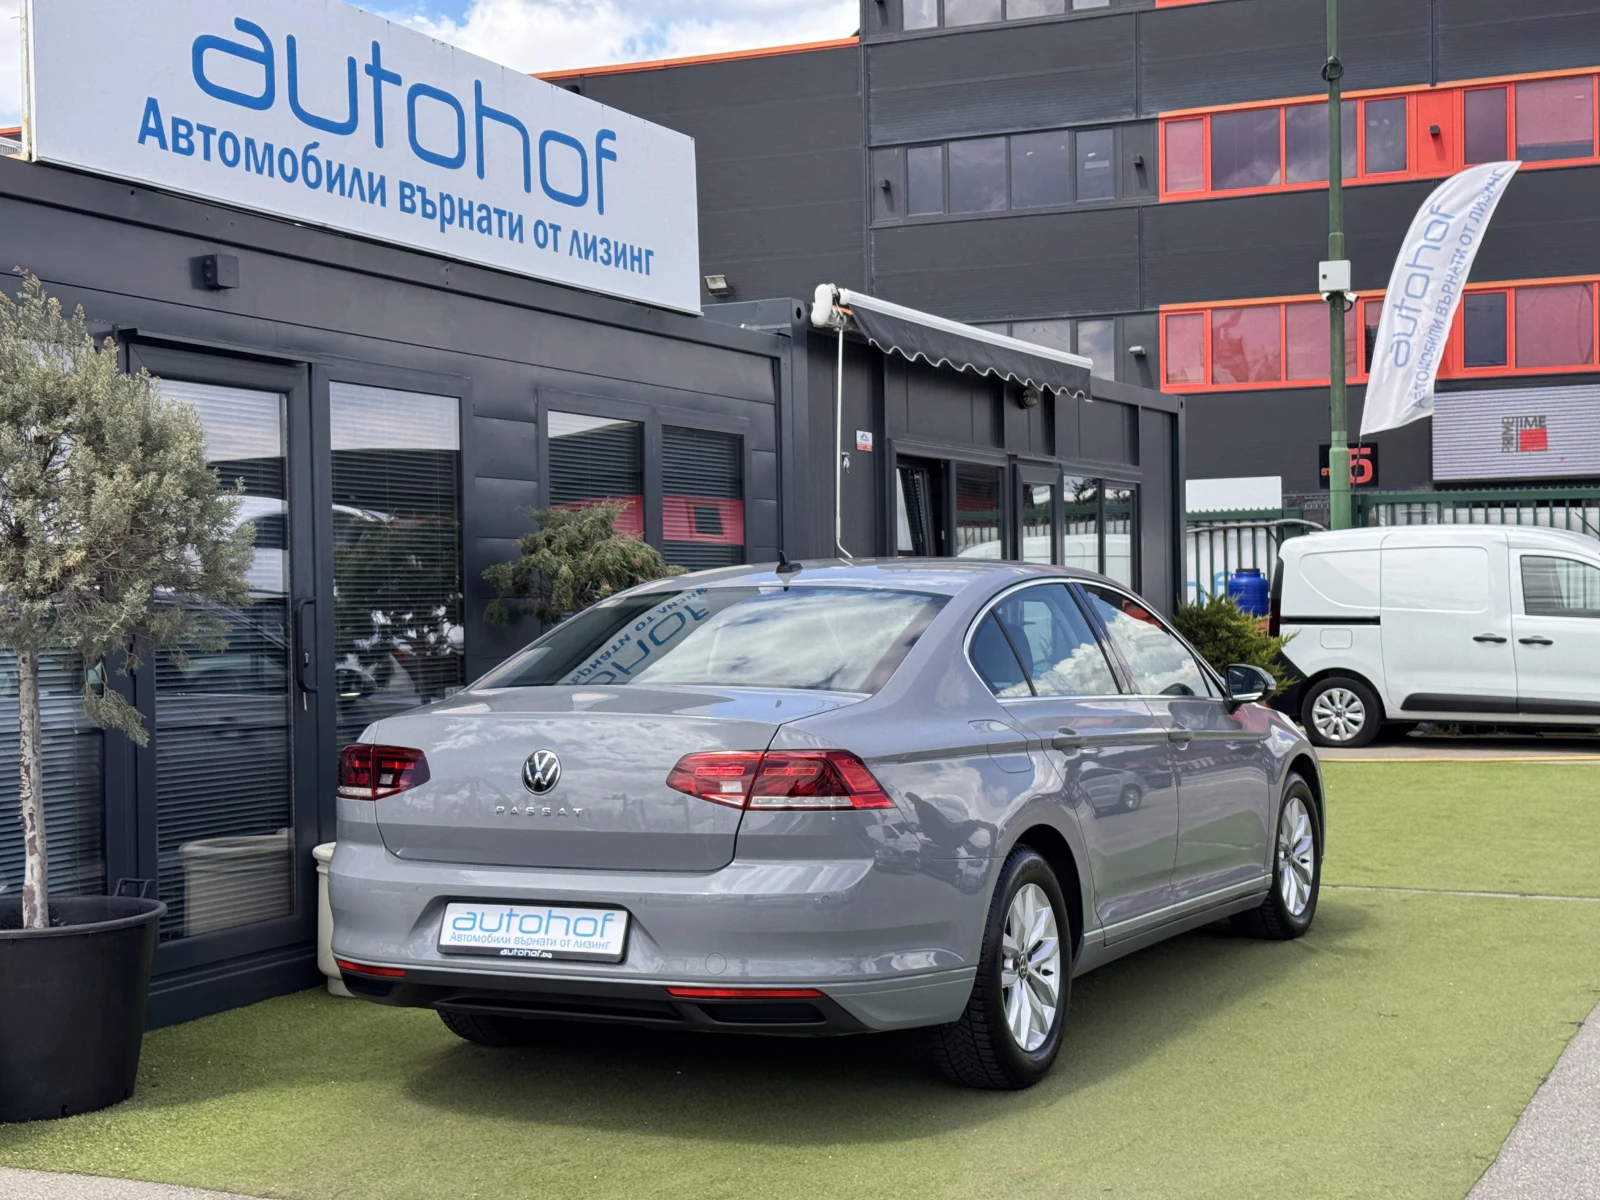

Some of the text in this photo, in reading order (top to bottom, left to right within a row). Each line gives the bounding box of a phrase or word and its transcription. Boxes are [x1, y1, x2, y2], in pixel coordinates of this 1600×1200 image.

[191, 17, 617, 215] autohof
[137, 96, 655, 276] Автомобили върнати от лизинг
[1458, 223, 1477, 246] ОТ
[1389, 203, 1456, 368] autohof
[495, 805, 583, 817] PASSAT
[452, 907, 615, 938] autohof
[450, 931, 611, 951] Автомобили върнати от лизинг
